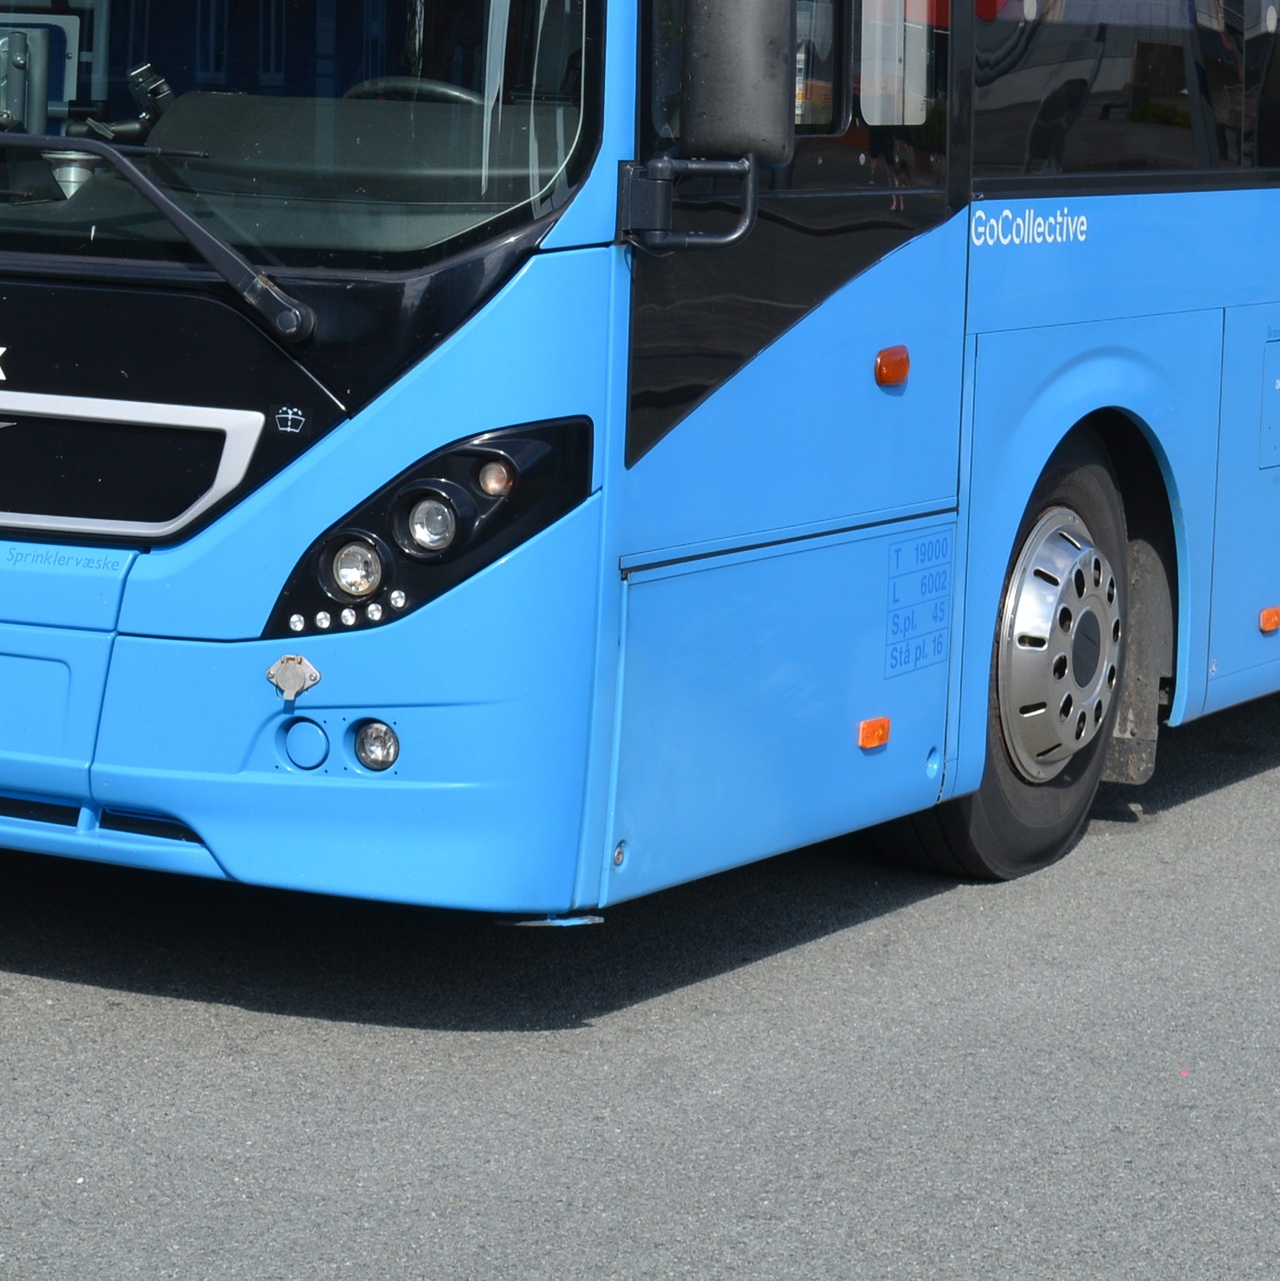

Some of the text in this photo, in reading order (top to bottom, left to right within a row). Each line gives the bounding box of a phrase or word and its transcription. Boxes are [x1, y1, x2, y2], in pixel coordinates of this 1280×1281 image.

[971, 206, 1088, 246] GoCollective
[894, 536, 948, 570] T 19000
[892, 582, 900, 604] L
[931, 601, 946, 624] 45
[931, 633, 944, 656] 16
